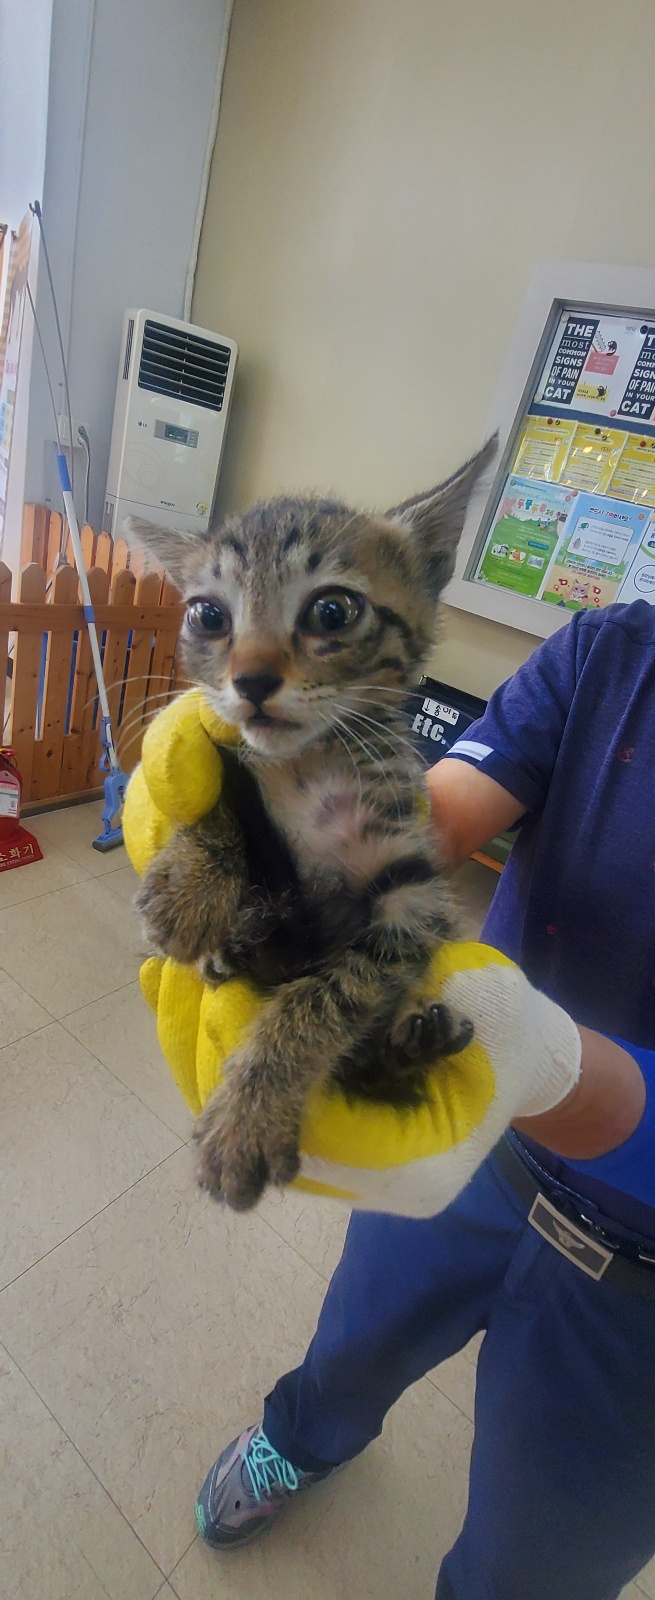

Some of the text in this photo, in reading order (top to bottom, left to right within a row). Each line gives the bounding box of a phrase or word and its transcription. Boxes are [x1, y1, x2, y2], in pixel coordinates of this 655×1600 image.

[567, 323, 594, 337] THE
[561, 339, 590, 350] most
[558, 348, 587, 357] COMMON
[555, 355, 583, 367] SIGNS
[551, 365, 580, 380] OF PAIN
[558, 379, 576, 387] YOUR
[628, 379, 641, 391] OF
[545, 386, 571, 400] CAT
[621, 400, 651, 415] CAT
[411, 713, 446, 745] Etc.
